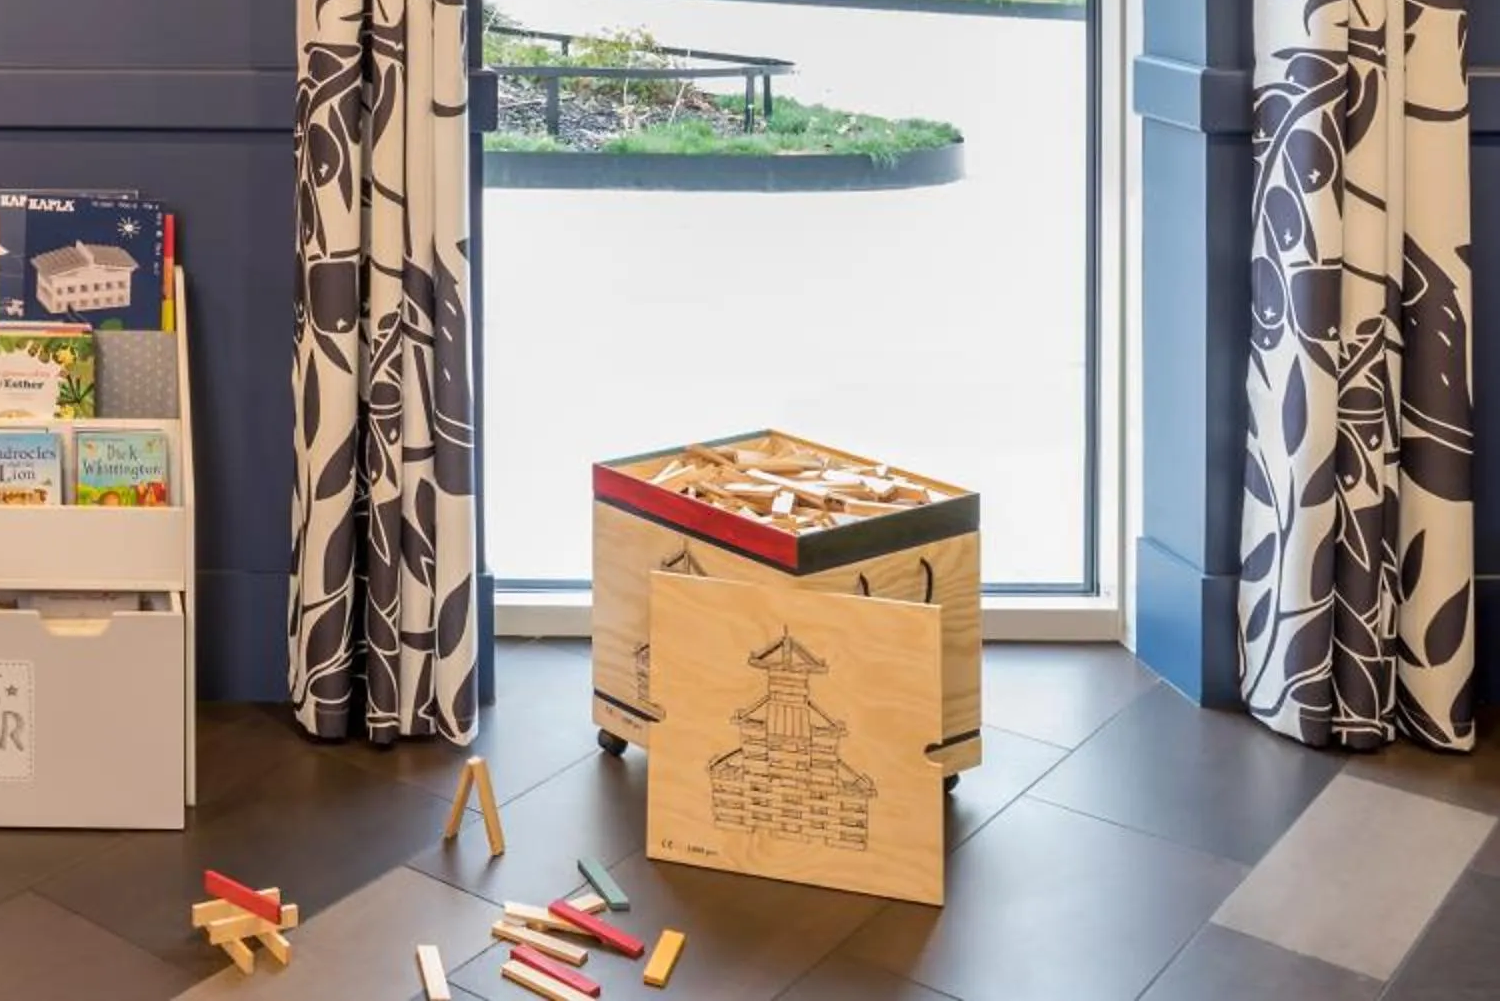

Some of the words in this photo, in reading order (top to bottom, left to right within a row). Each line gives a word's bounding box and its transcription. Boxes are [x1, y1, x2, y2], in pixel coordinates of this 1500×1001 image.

[0, 194, 28, 207] KAP
[28, 198, 76, 212] KAPLA
[82, 459, 162, 480] Whittington
